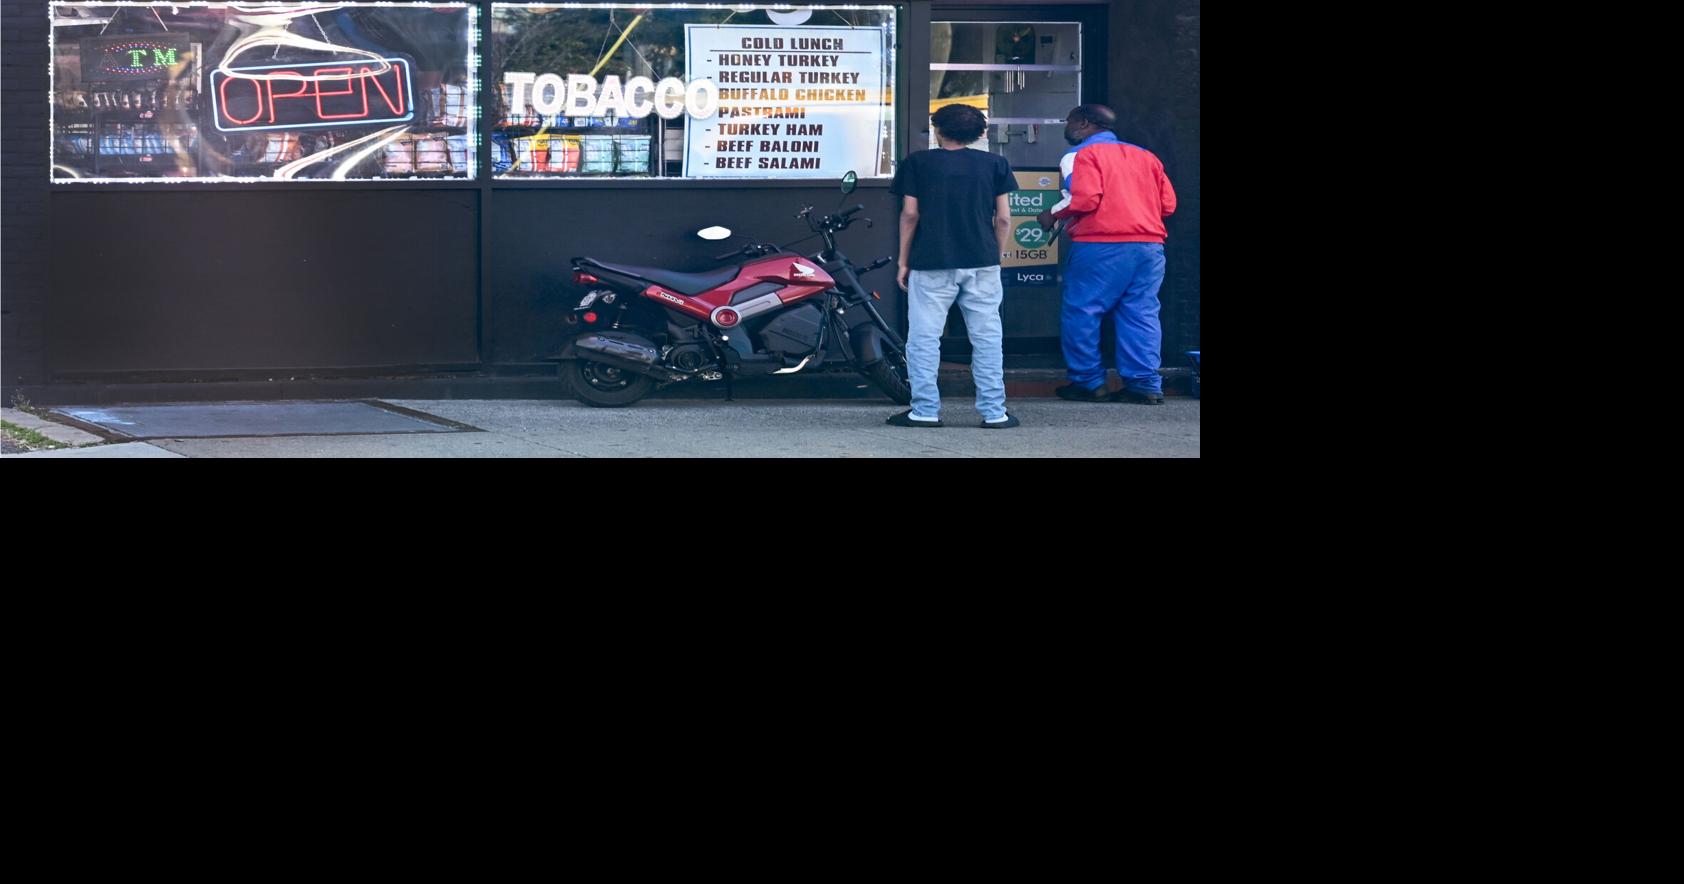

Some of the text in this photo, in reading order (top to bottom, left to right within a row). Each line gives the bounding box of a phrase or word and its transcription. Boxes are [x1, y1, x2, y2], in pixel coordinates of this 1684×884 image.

[741, 37, 844, 51] COLD LUNCH
[718, 54, 839, 67] HONEY TURKEY
[719, 71, 860, 85] REGULAR TURKEY
[219, 64, 404, 125] OPEN
[503, 71, 718, 120] TOBACCO
[718, 88, 866, 102] BUFFALO CHICKEN
[718, 106, 806, 119] PASTRAMI
[717, 123, 823, 136] TURKEY HAM
[716, 140, 819, 153] BEEF BALONI
[715, 157, 821, 169] BEEF SALAMI
[1009, 192, 1043, 207] ited
[1015, 249, 1048, 260] 15GB
[1017, 272, 1044, 282] Lyca
